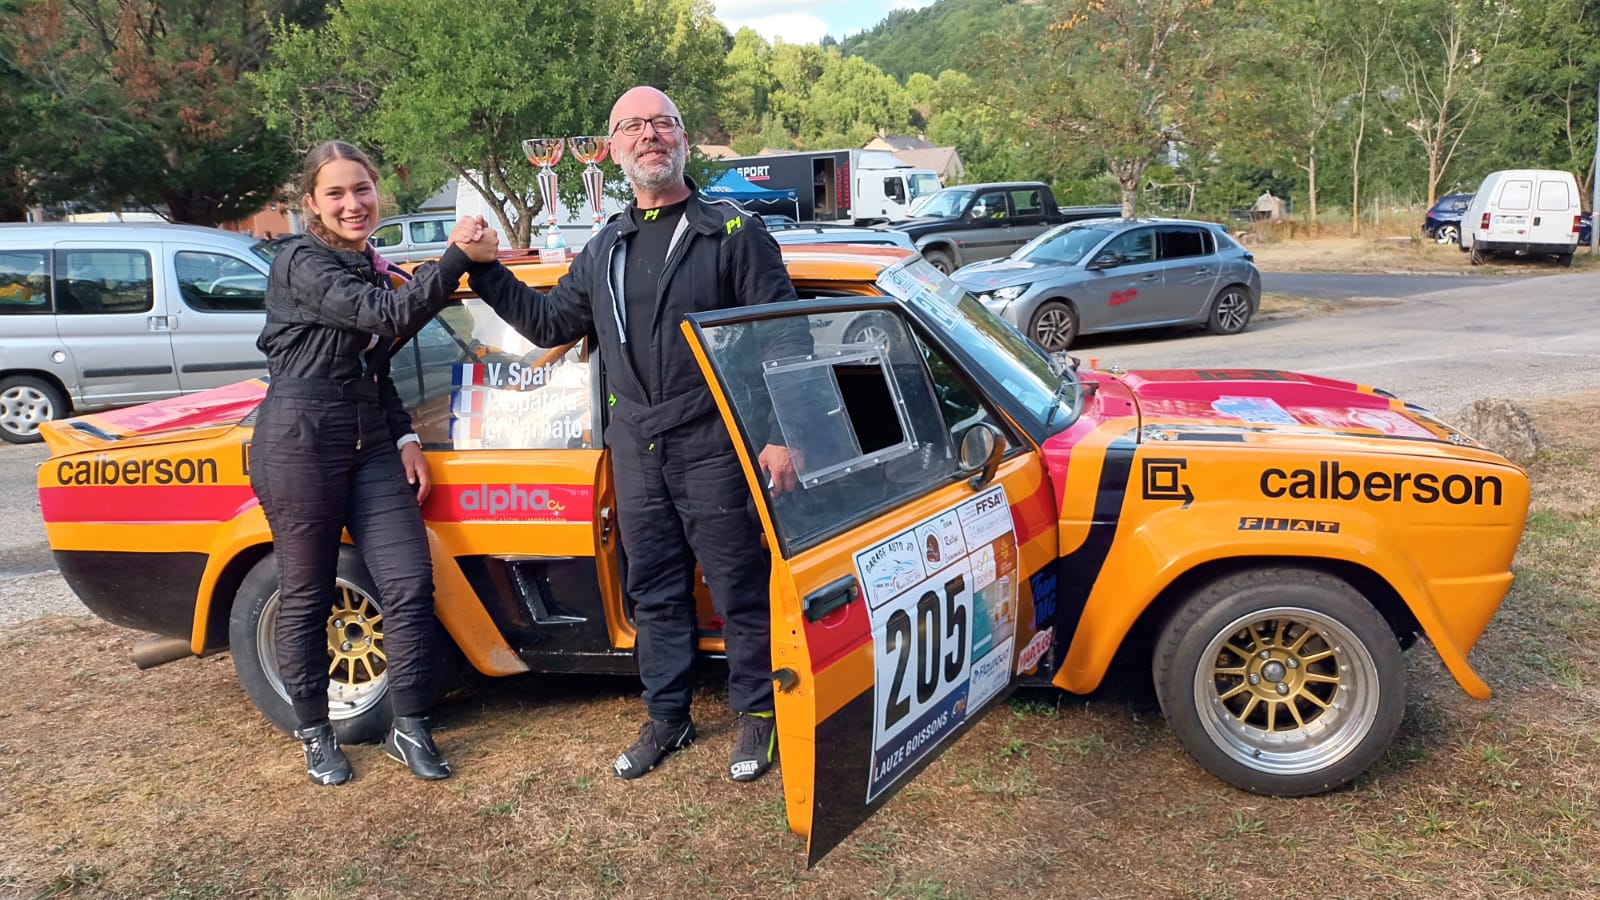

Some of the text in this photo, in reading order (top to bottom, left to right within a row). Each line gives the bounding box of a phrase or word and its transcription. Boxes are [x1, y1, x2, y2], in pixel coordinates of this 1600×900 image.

[736, 165, 770, 177] SPORT
[643, 208, 661, 221] P1
[724, 216, 743, 236] P1
[488, 363, 503, 386] V.
[57, 454, 218, 485] calberson
[1260, 461, 1503, 506] calberson
[460, 484, 548, 514] alpha
[976, 494, 1001, 514] FFSA
[1241, 517, 1339, 533] FIAT
[865, 547, 887, 572] GARAGE
[889, 540, 904, 552] AUTO
[885, 573, 966, 731] 205
[874, 711, 948, 783] LAUZE BOISSONS
[731, 763, 759, 775] OMP
